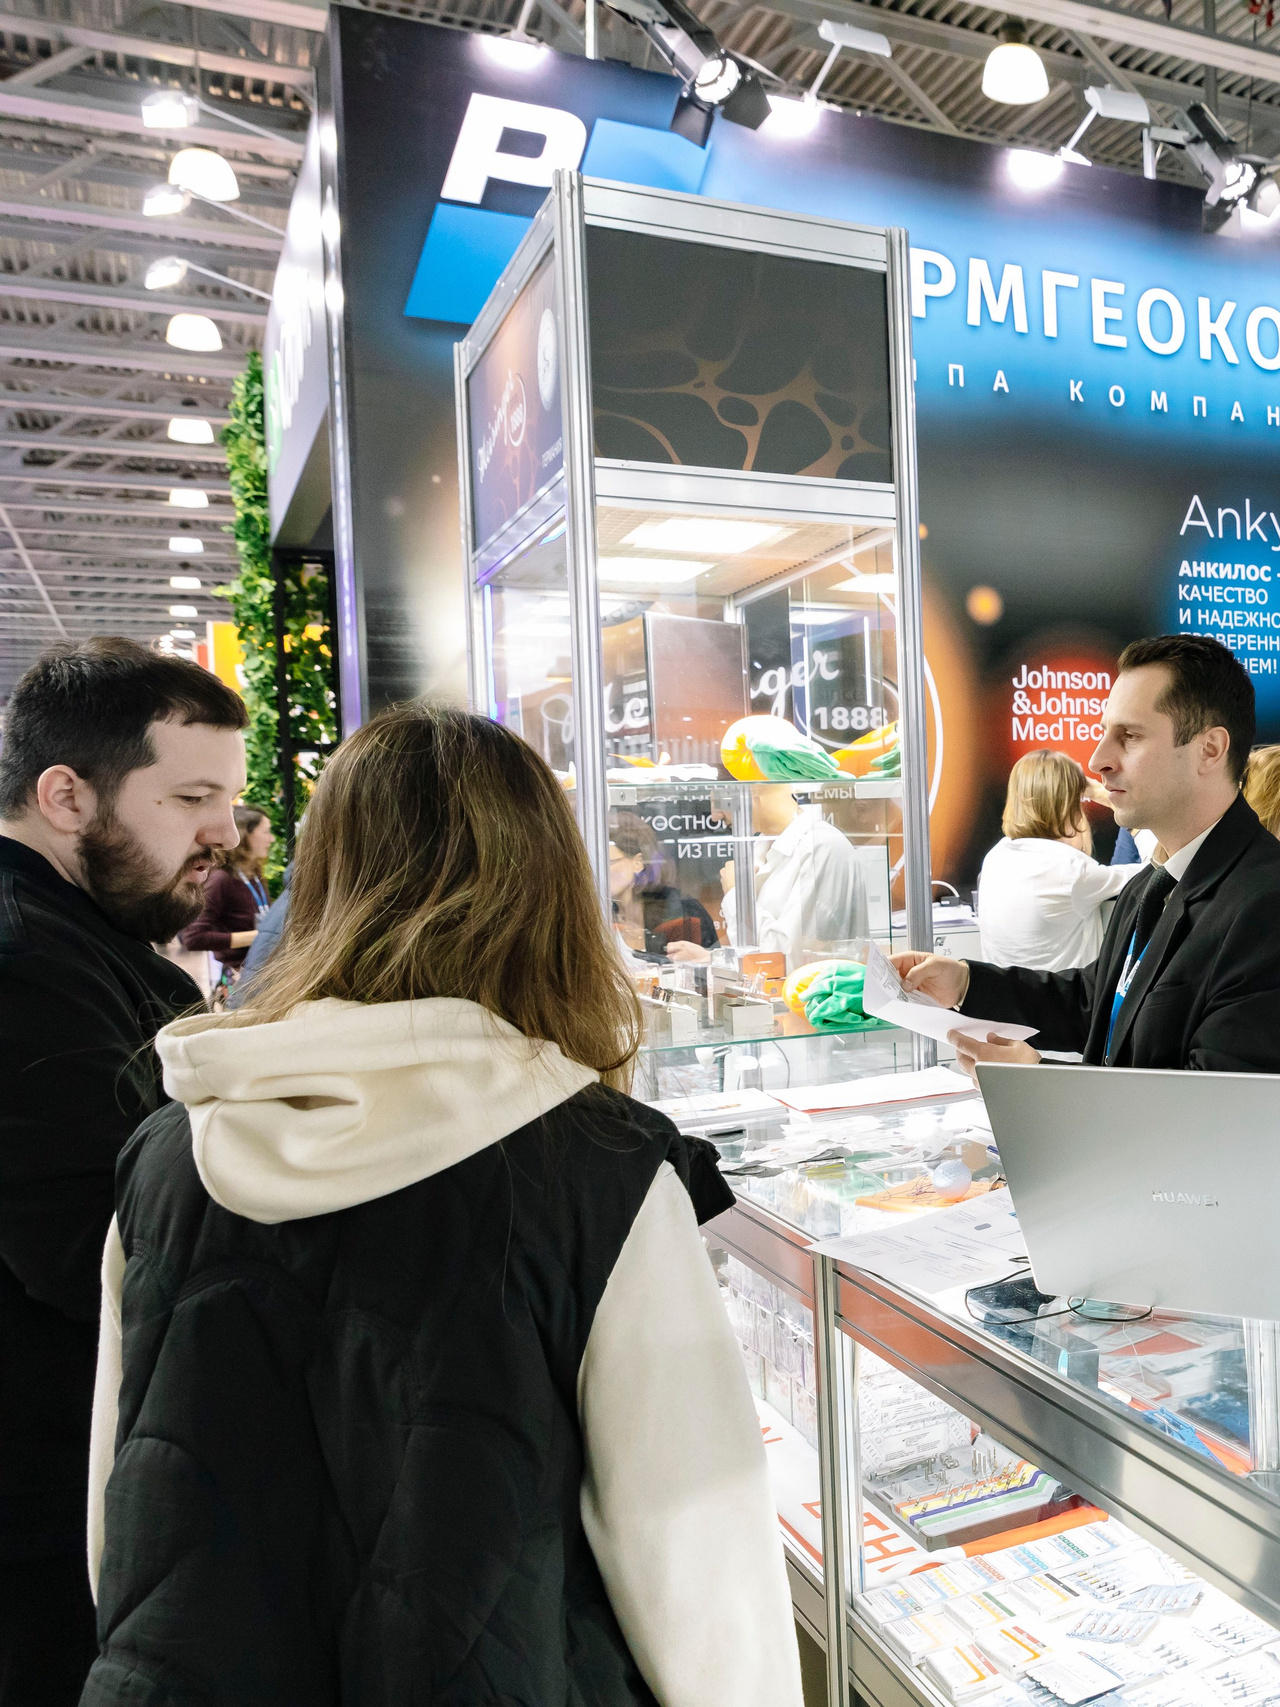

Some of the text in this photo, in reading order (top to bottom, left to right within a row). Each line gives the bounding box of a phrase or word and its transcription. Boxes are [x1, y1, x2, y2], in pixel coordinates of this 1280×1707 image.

[1178, 560, 1272, 582] АНКИЛОС
[1178, 584, 1269, 605] КАЧЕСТВО
[1179, 608, 1191, 625] И
[1012, 664, 1111, 690] Johnson
[1012, 690, 1109, 715] &Johns
[814, 706, 888, 730] 1888
[1012, 717, 1105, 741] MedTec
[678, 843, 702, 859] ИЗ
